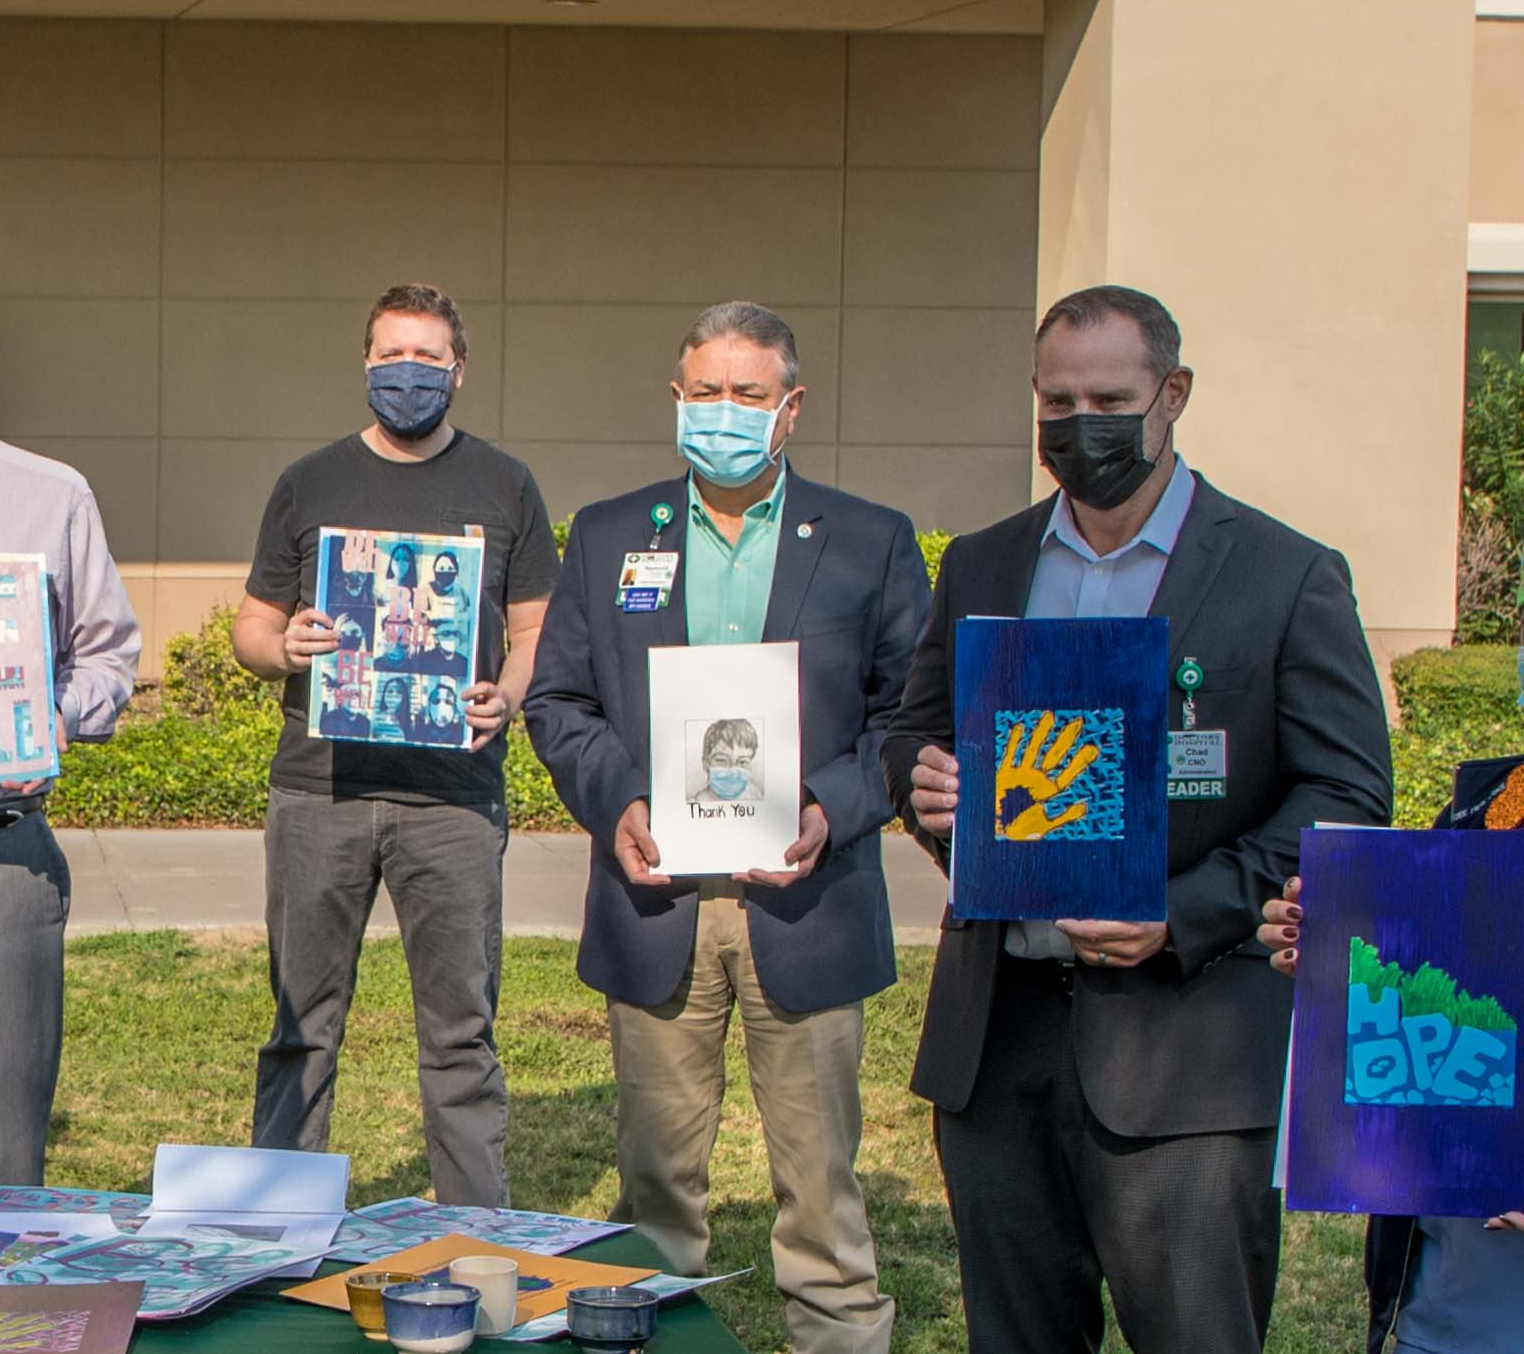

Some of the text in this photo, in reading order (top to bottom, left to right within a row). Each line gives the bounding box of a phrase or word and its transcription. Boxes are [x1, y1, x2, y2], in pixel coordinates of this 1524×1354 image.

[337, 649, 374, 687] BE
[1167, 781, 1223, 796] EADER
[1347, 982, 1507, 1100] HOPE
